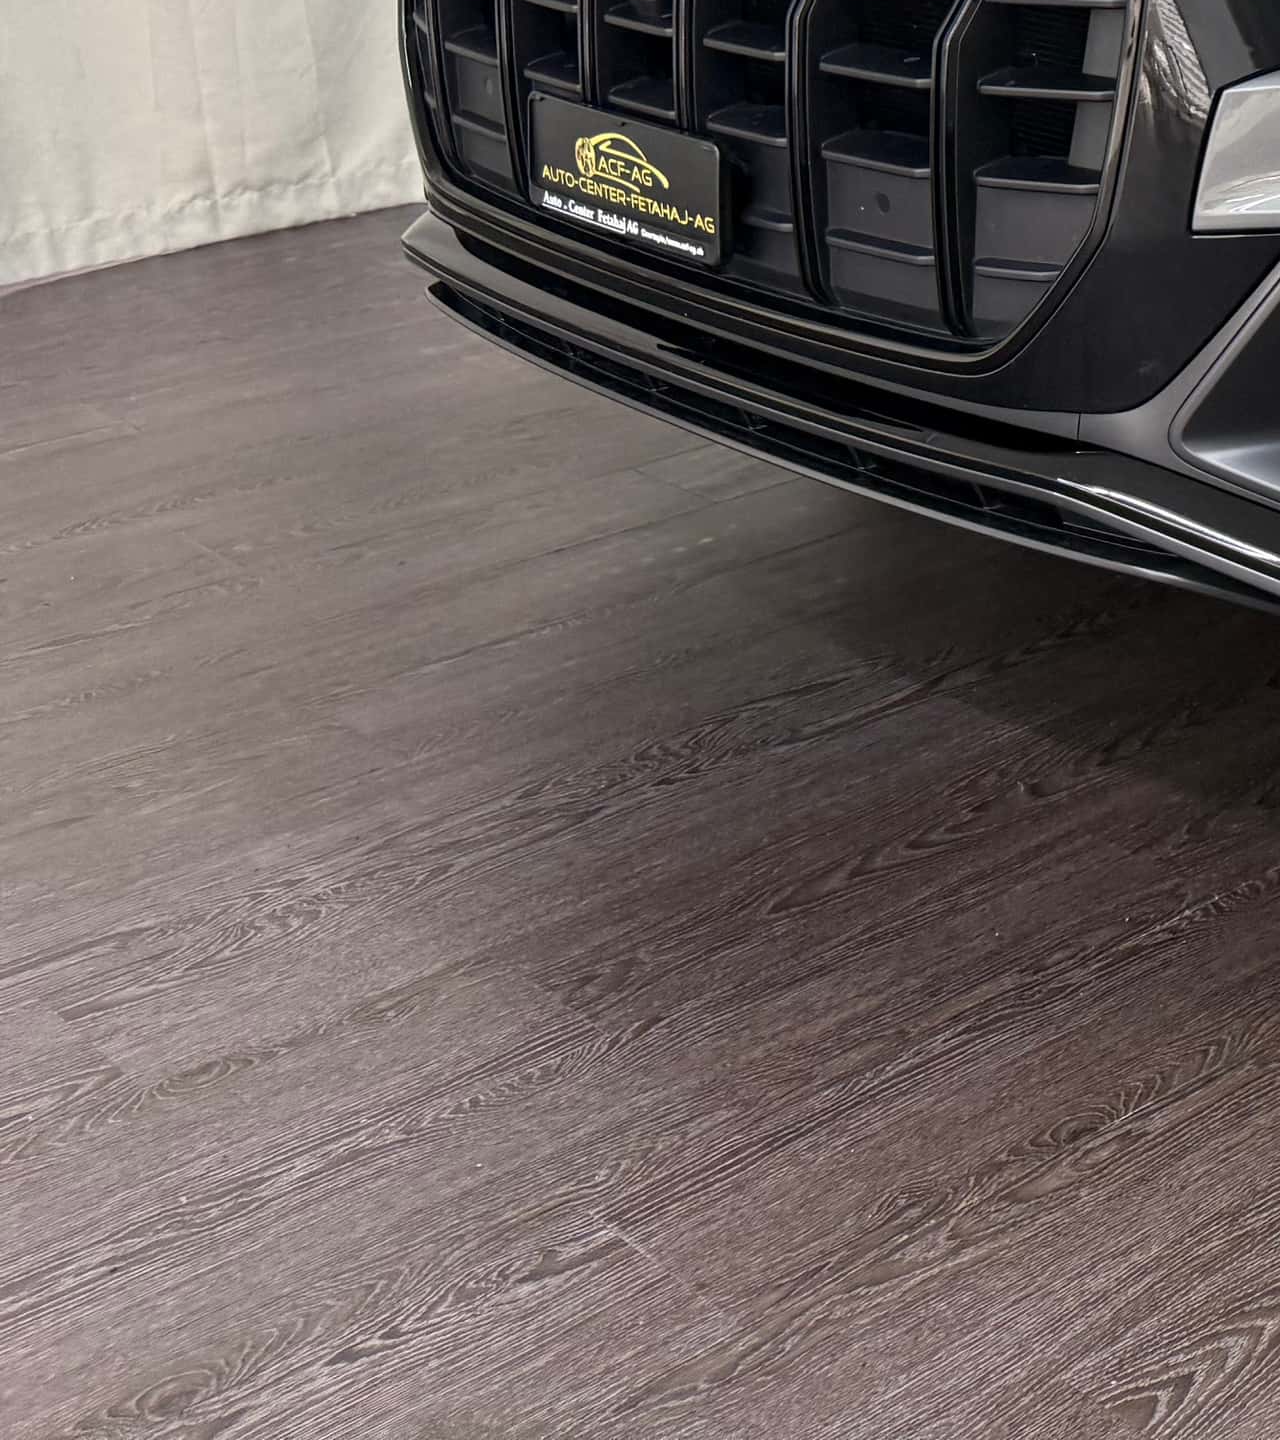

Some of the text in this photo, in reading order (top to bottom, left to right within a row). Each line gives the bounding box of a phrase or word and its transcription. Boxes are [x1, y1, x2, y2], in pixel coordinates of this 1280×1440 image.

[598, 156, 653, 187] ACF-AG
[542, 164, 716, 235] AUTO-CENTER-FETAHAJ-AG
[627, 219, 639, 235] AG
